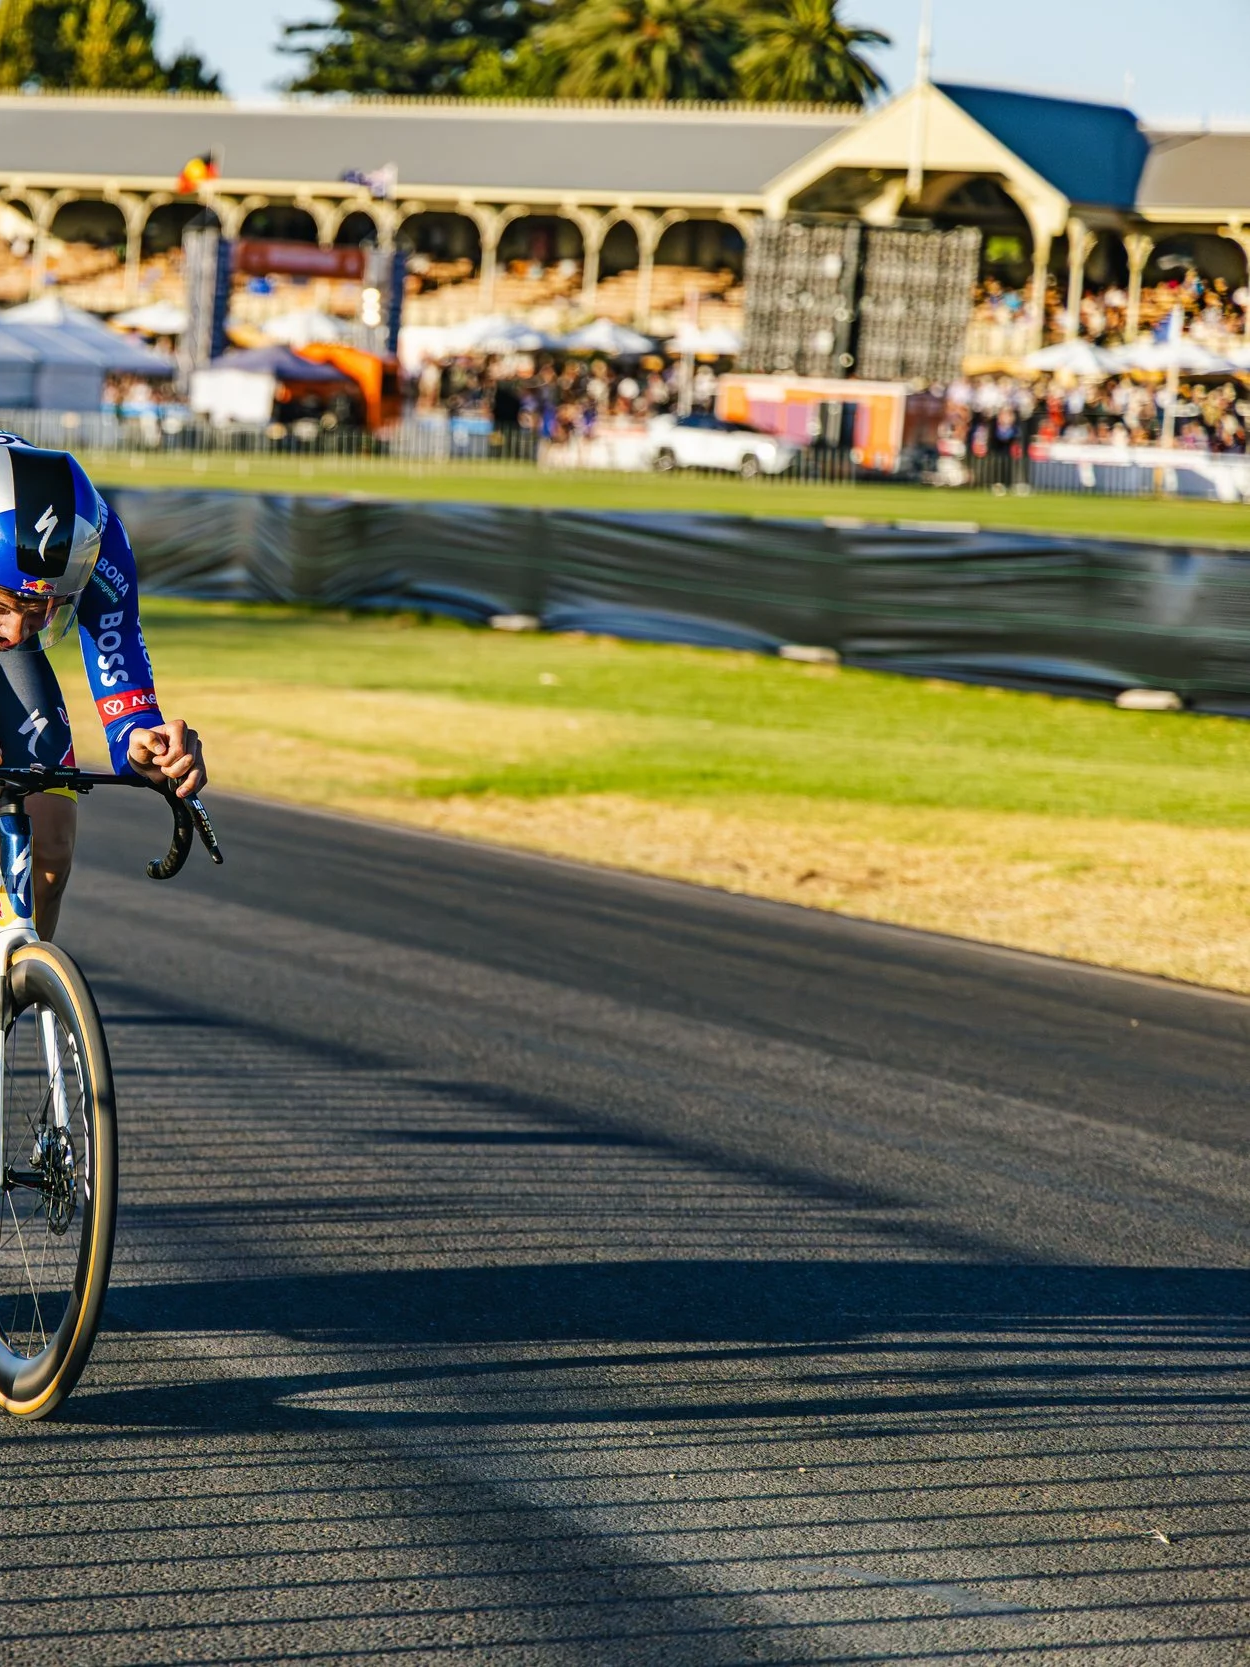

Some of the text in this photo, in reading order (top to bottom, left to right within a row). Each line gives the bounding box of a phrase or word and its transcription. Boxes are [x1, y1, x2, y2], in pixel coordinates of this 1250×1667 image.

[91, 570, 119, 603] hansgrohe
[96, 556, 129, 597] BORA
[97, 610, 129, 687] BOSS
